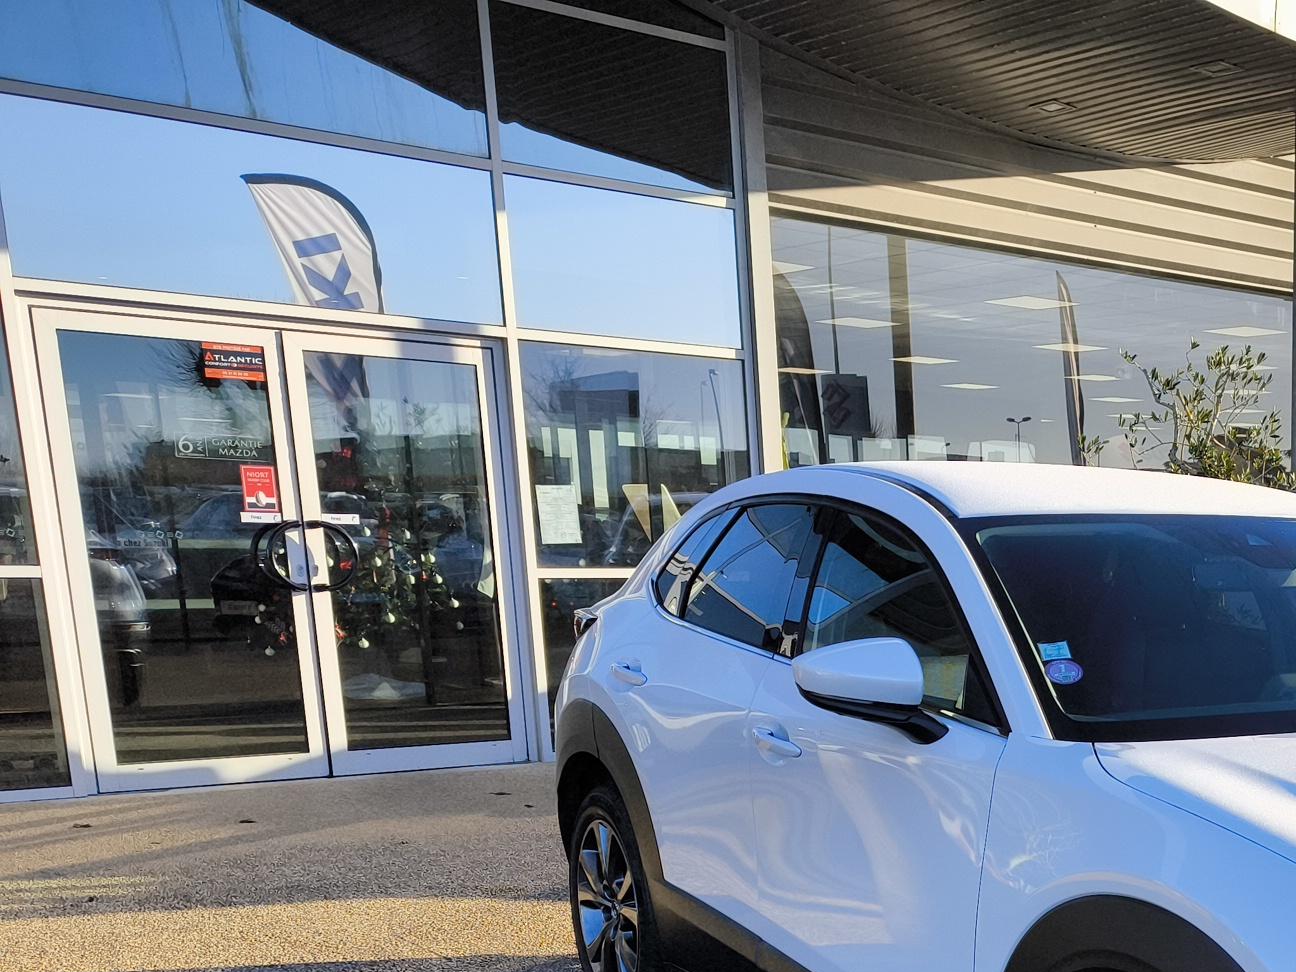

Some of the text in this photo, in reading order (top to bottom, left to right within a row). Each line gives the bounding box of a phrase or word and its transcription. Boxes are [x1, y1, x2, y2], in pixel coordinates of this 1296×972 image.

[204, 351, 263, 365] ATLANTIC
[211, 438, 263, 449] GARANTIE
[218, 448, 258, 457] MAZDA
